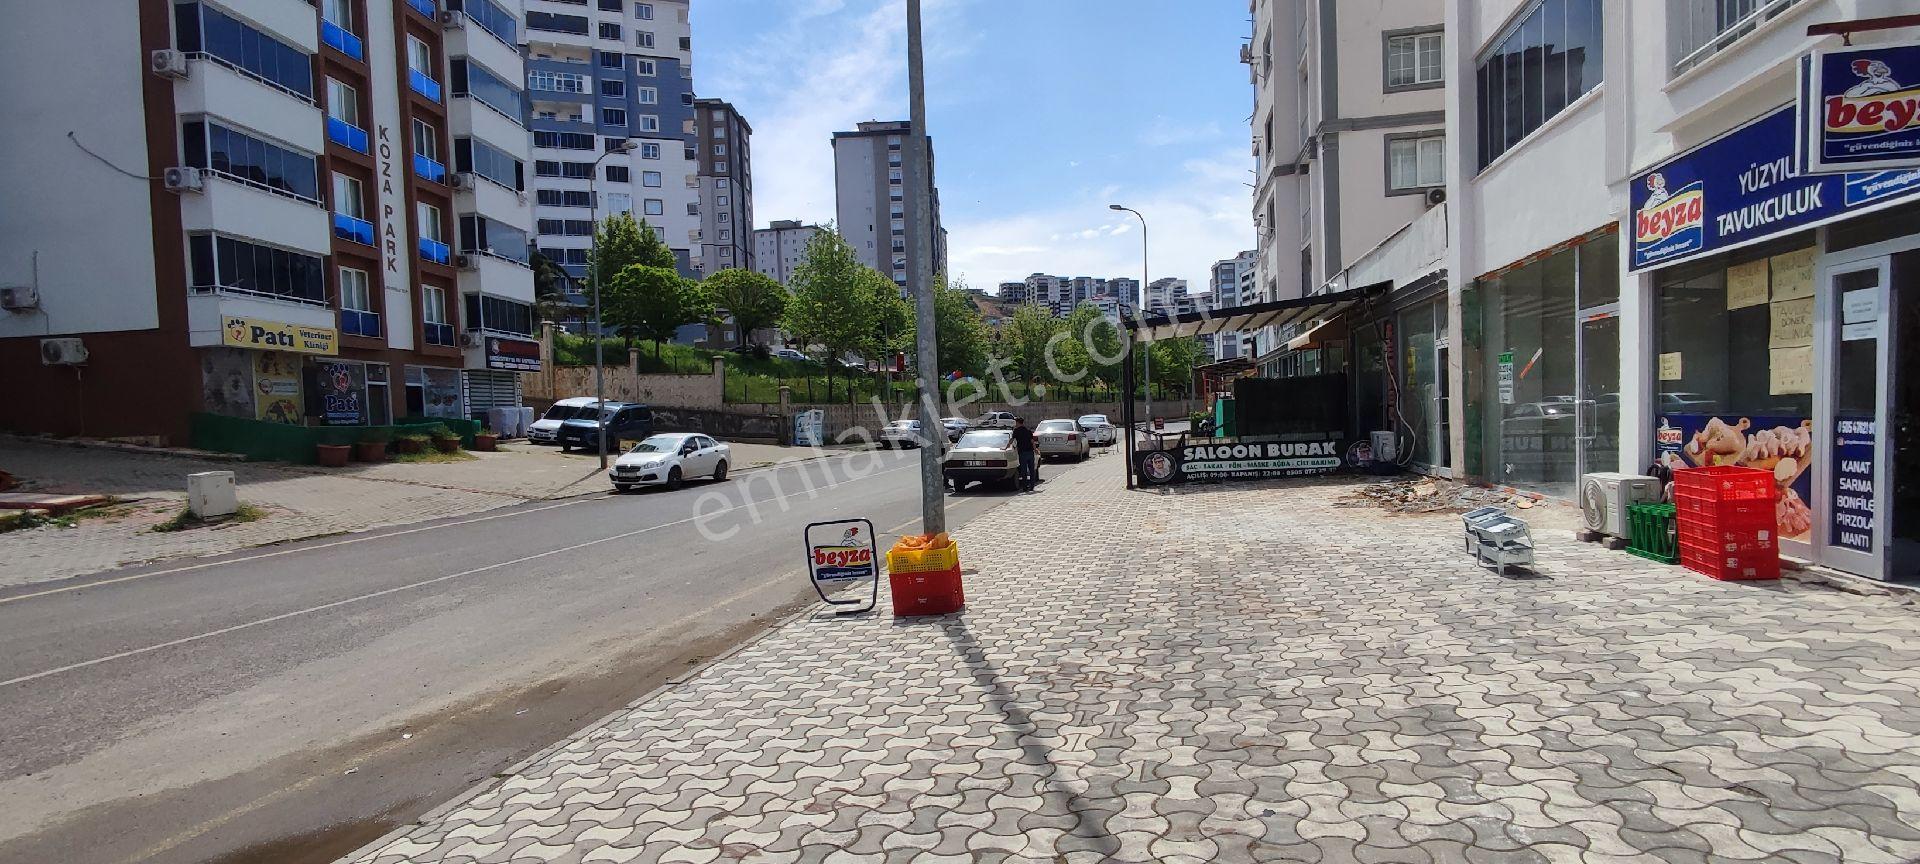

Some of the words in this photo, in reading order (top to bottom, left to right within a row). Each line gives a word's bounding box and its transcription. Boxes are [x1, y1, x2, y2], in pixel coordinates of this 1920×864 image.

[1825, 96, 1920, 131] bey
[378, 125, 393, 196] KOZA
[1637, 196, 1702, 238] beyza
[1716, 182, 1823, 237] TAVUKCULUK
[384, 204, 397, 273] PARK
[250, 324, 294, 347] Pati
[299, 329, 332, 340] Veteriner
[1183, 444, 1262, 460] SALOON
[1267, 441, 1336, 457] BURAK
[1841, 459, 1872, 474] KANAT
[1839, 477, 1873, 493] SARMA
[1836, 495, 1875, 512] BONFİLE
[1836, 510, 1875, 530] PİRZOLA
[1841, 531, 1869, 548] MANTI
[814, 548, 871, 567] beyza
